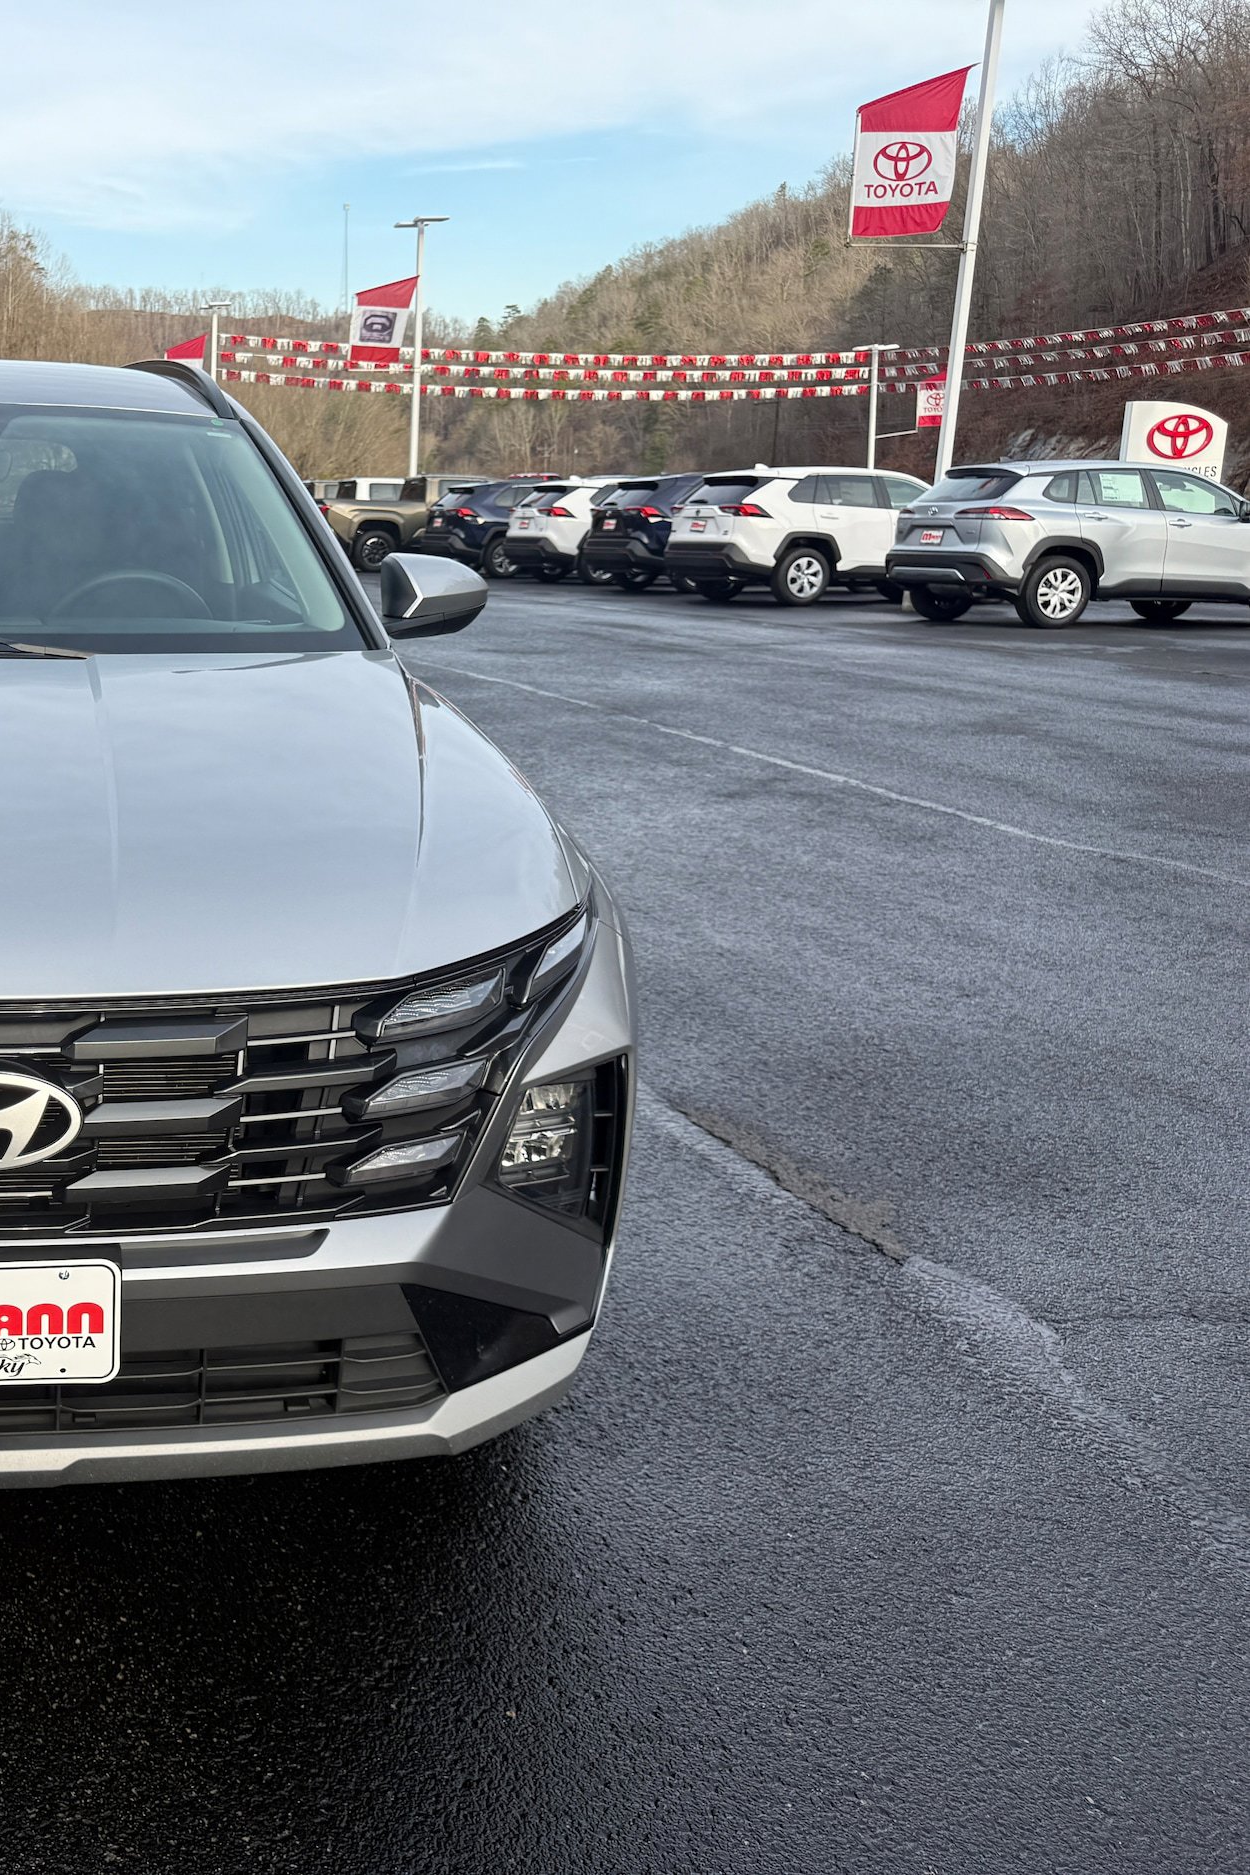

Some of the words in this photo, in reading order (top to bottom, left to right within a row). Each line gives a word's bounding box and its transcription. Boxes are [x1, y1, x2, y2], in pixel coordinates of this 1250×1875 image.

[863, 181, 939, 199] TOYOTA
[923, 406, 943, 414] TOYO
[18, 1336, 96, 1350] TOYOTA
